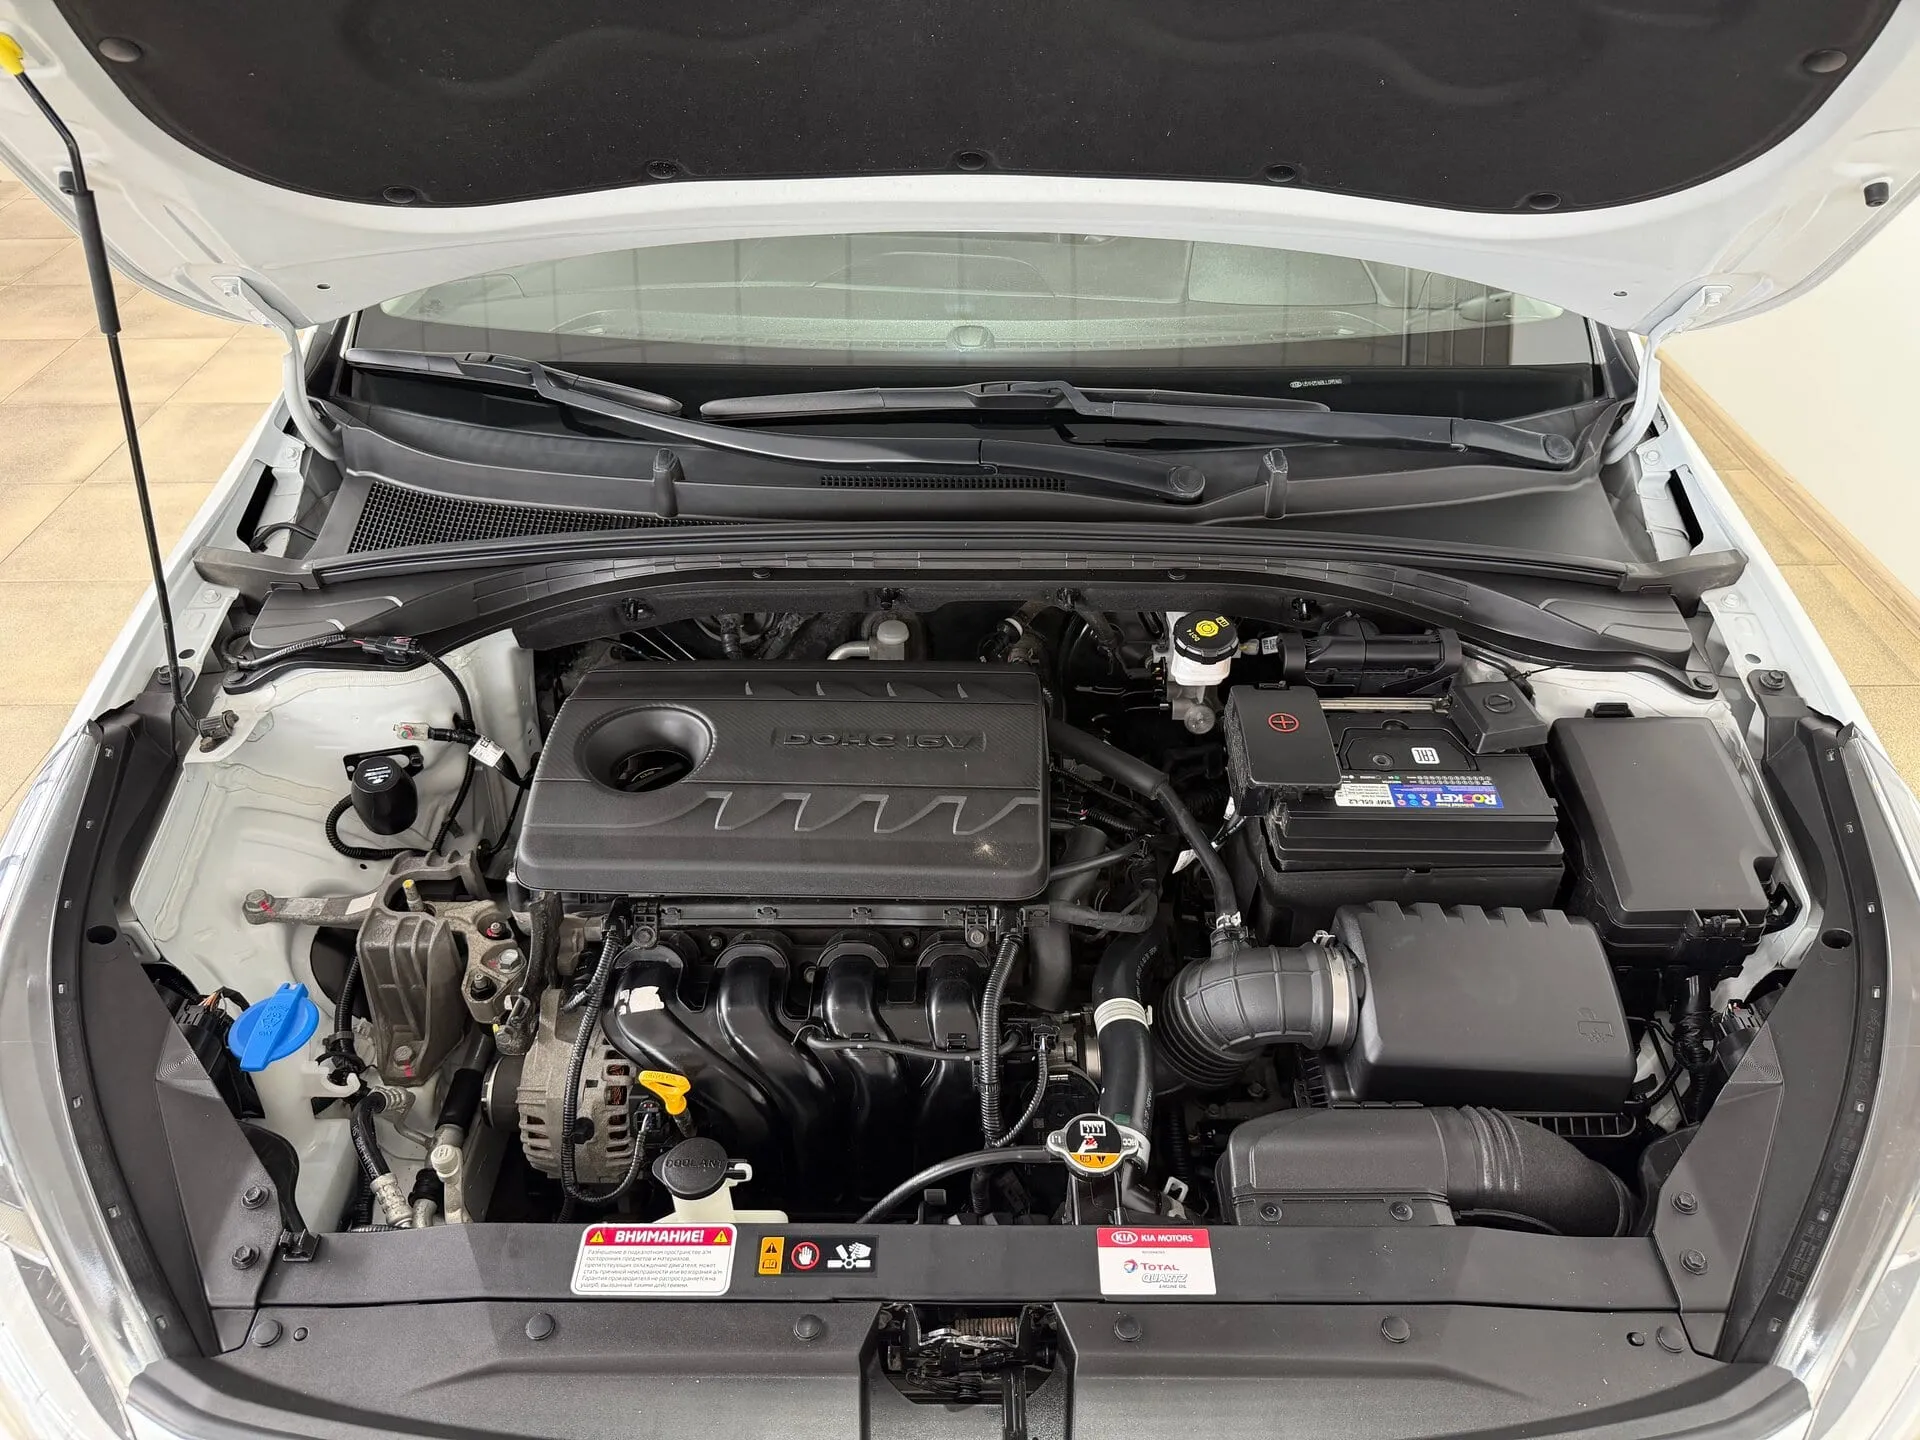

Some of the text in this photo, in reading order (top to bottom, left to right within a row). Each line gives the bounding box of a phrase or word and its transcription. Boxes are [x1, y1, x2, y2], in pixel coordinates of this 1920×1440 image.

[784, 732, 973, 748] DOHC 16V
[1435, 793, 1497, 805] ROCKET
[665, 1158, 723, 1168] COOLANT
[614, 1230, 704, 1244] ВНИМАНИЕ!
[1141, 1234, 1193, 1242] KIA MOTORS
[1140, 1262, 1180, 1271] TOTAL
[1141, 1273, 1188, 1284] QUARTZ
